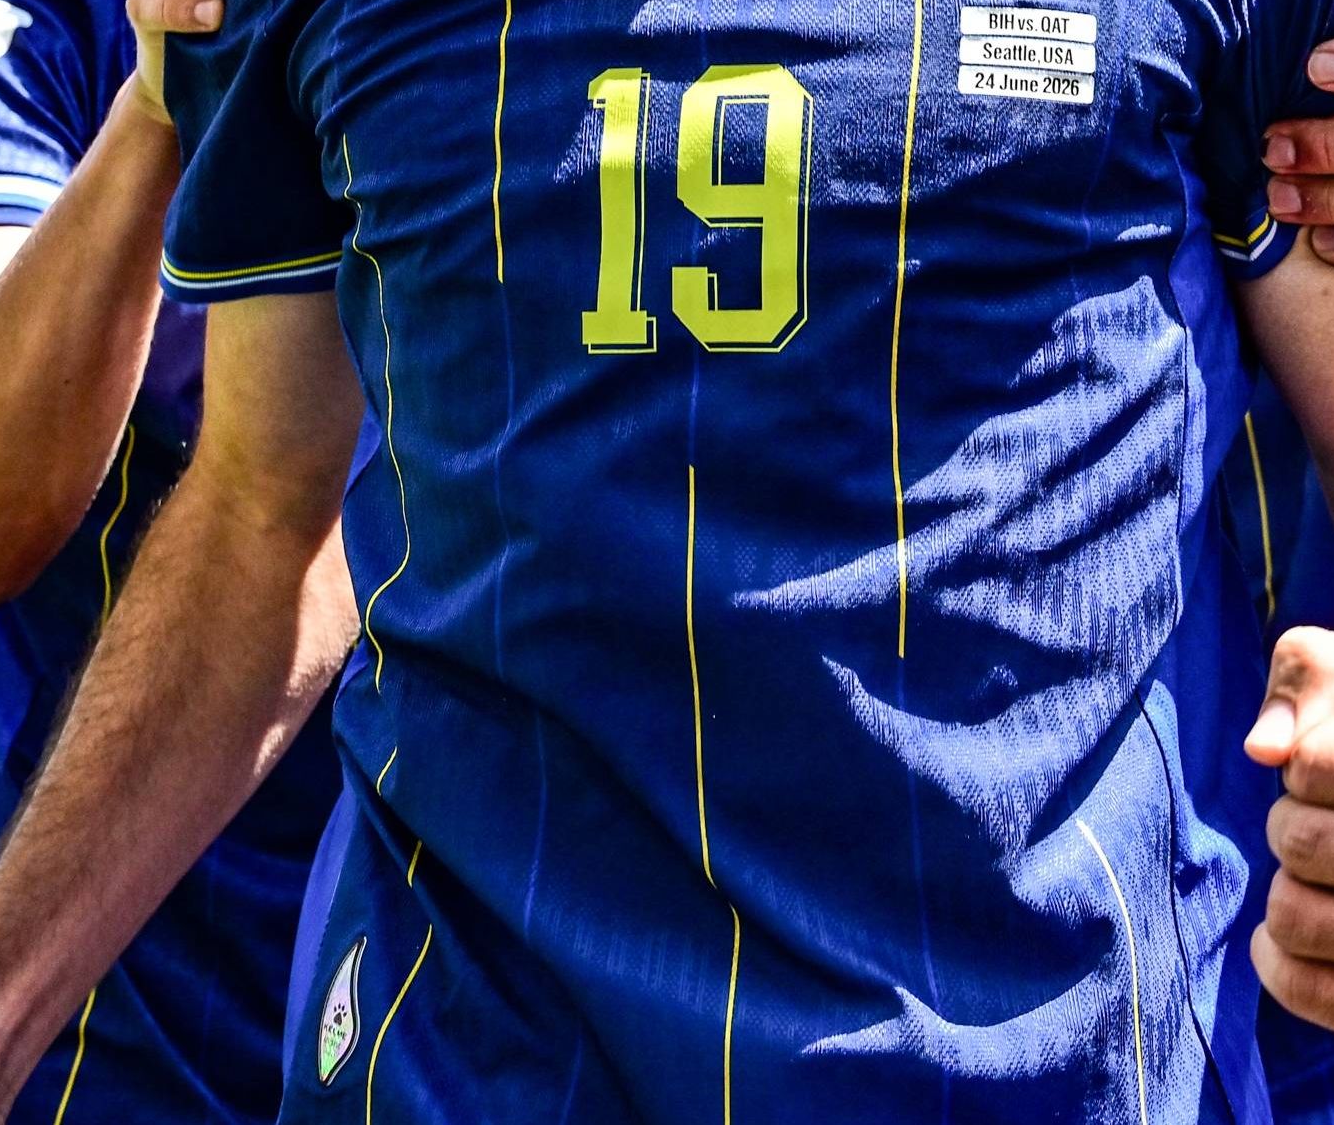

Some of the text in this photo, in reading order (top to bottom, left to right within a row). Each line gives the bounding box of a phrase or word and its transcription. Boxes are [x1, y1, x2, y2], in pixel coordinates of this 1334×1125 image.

[989, 13, 1070, 34] BIH vs. QAT
[975, 72, 1080, 97] 24 June 2026
[582, 63, 814, 354] 19
